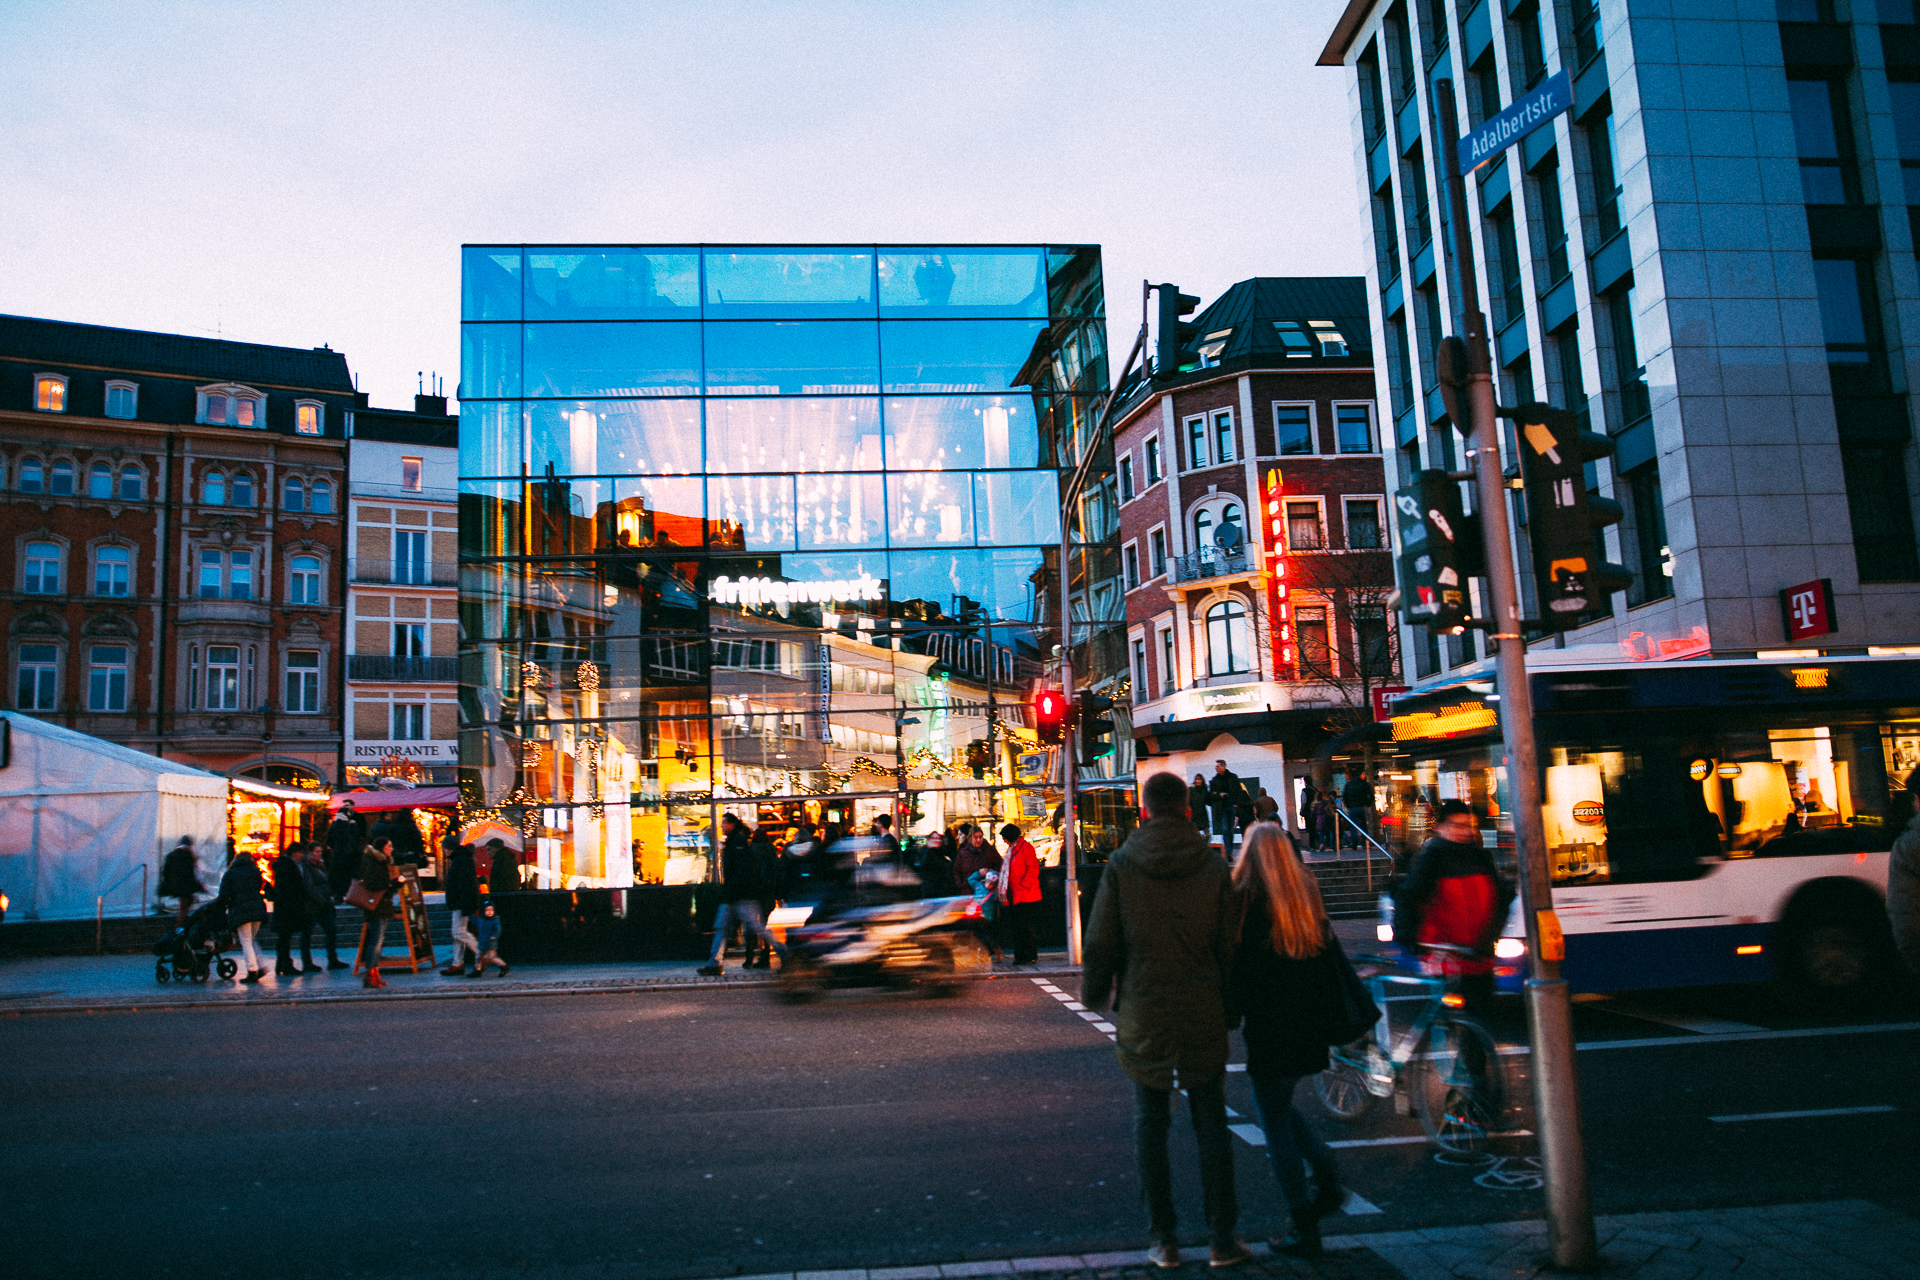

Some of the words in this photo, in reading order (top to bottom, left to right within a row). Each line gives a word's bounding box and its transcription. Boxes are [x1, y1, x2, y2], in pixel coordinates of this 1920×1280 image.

[1471, 91, 1558, 160] Adalbertstr.
[1792, 591, 1816, 629] T
[354, 745, 440, 756] RISTORANTE
